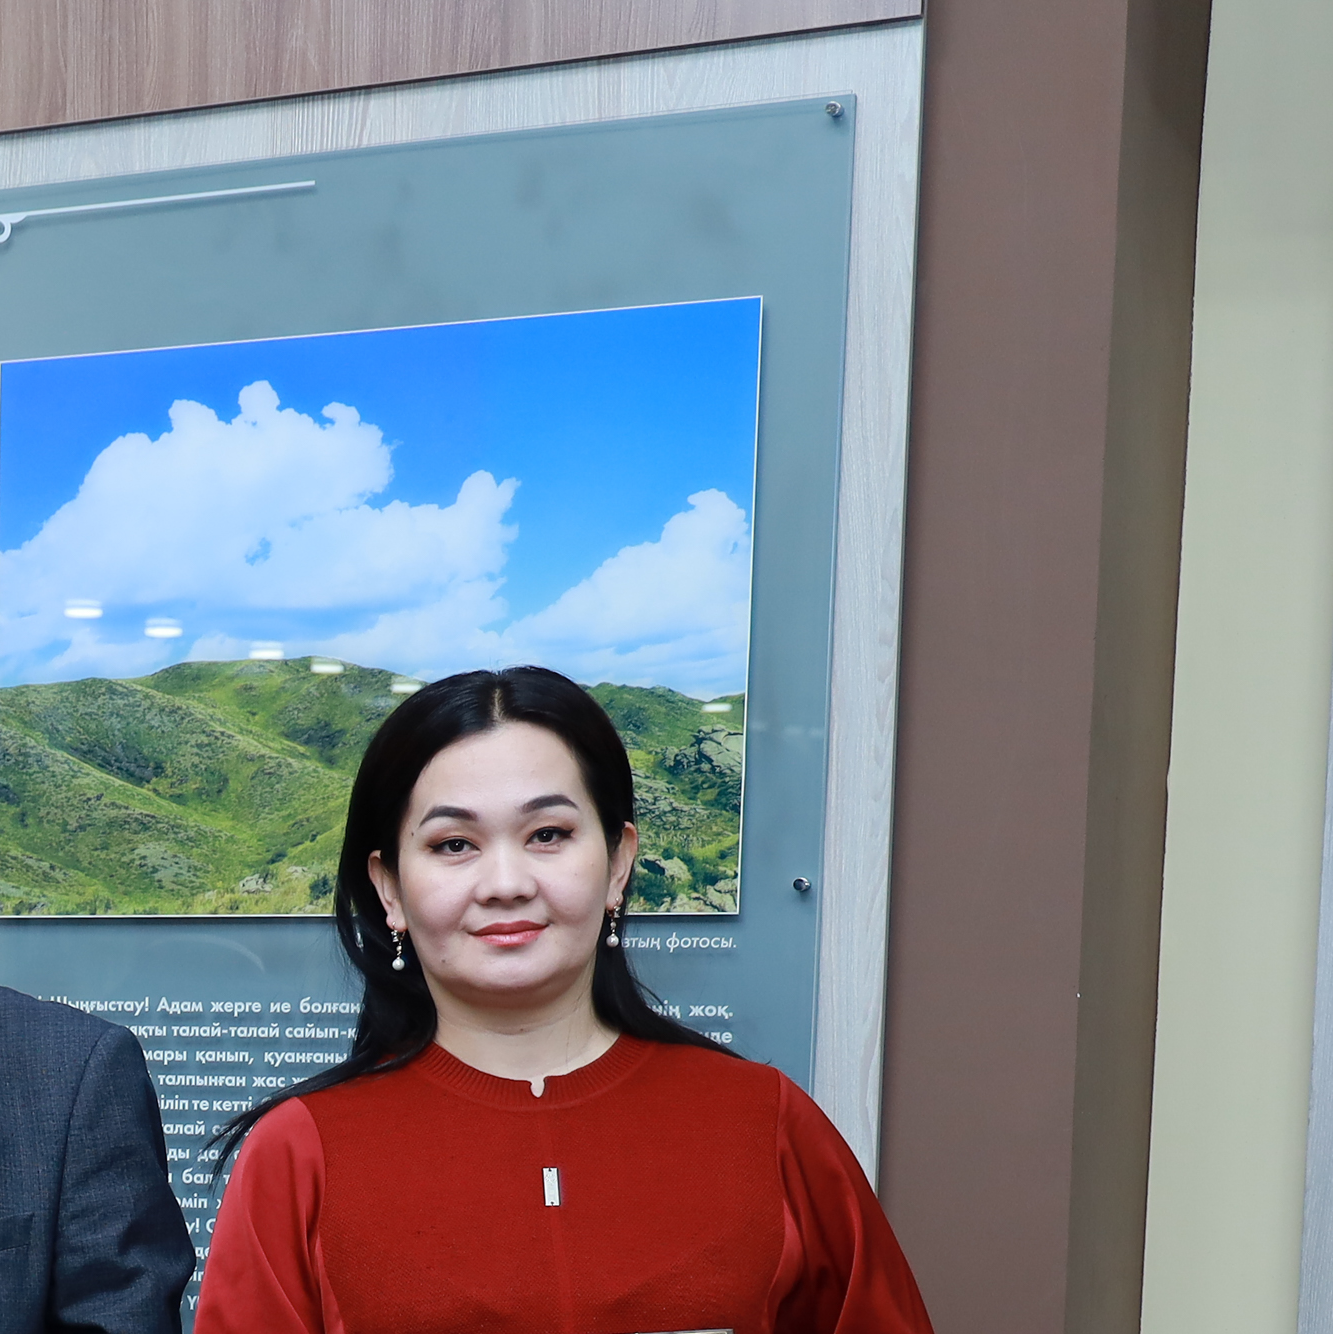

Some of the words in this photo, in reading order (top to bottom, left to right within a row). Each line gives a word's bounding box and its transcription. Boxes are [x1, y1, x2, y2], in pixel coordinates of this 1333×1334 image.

[666, 932, 737, 952] фотосы.
[157, 996, 203, 1017] Адам
[210, 1000, 262, 1017] жерге
[270, 1001, 291, 1013] ие
[300, 997, 361, 1014] болған
[689, 1005, 733, 1018] жоқ.
[172, 1021, 280, 1038] талай-талай
[196, 1051, 254, 1065] қанып,
[158, 1074, 246, 1088] талпынған
[252, 1075, 285, 1088] жас
[192, 1100, 209, 1111] те
